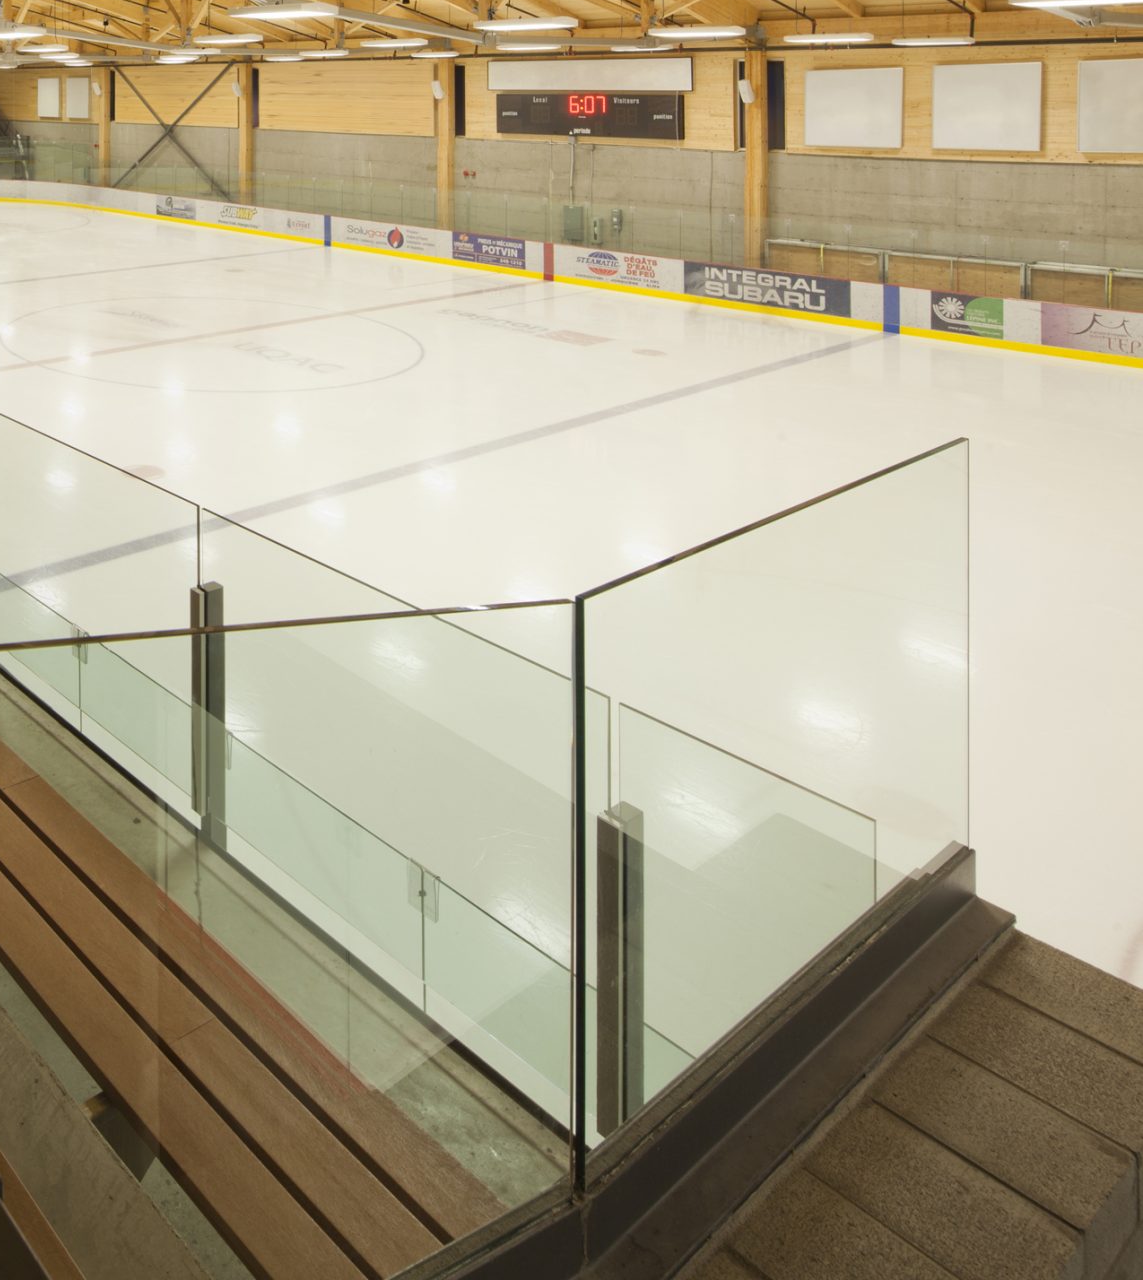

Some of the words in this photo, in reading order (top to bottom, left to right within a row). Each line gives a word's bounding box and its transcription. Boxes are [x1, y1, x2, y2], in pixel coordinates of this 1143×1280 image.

[569, 95, 606, 114] 6:07
[613, 97, 640, 105] Visiteurs
[220, 205, 258, 221] SUBWAY
[347, 224, 387, 239] Solugaz
[482, 245, 518, 258] POTVIN
[576, 256, 620, 267] STEAMATIC
[624, 256, 658, 266] DÉGÂTS
[626, 269, 637, 277] DE
[705, 266, 826, 294] INTEGRAL
[705, 280, 826, 311] SUBARU
